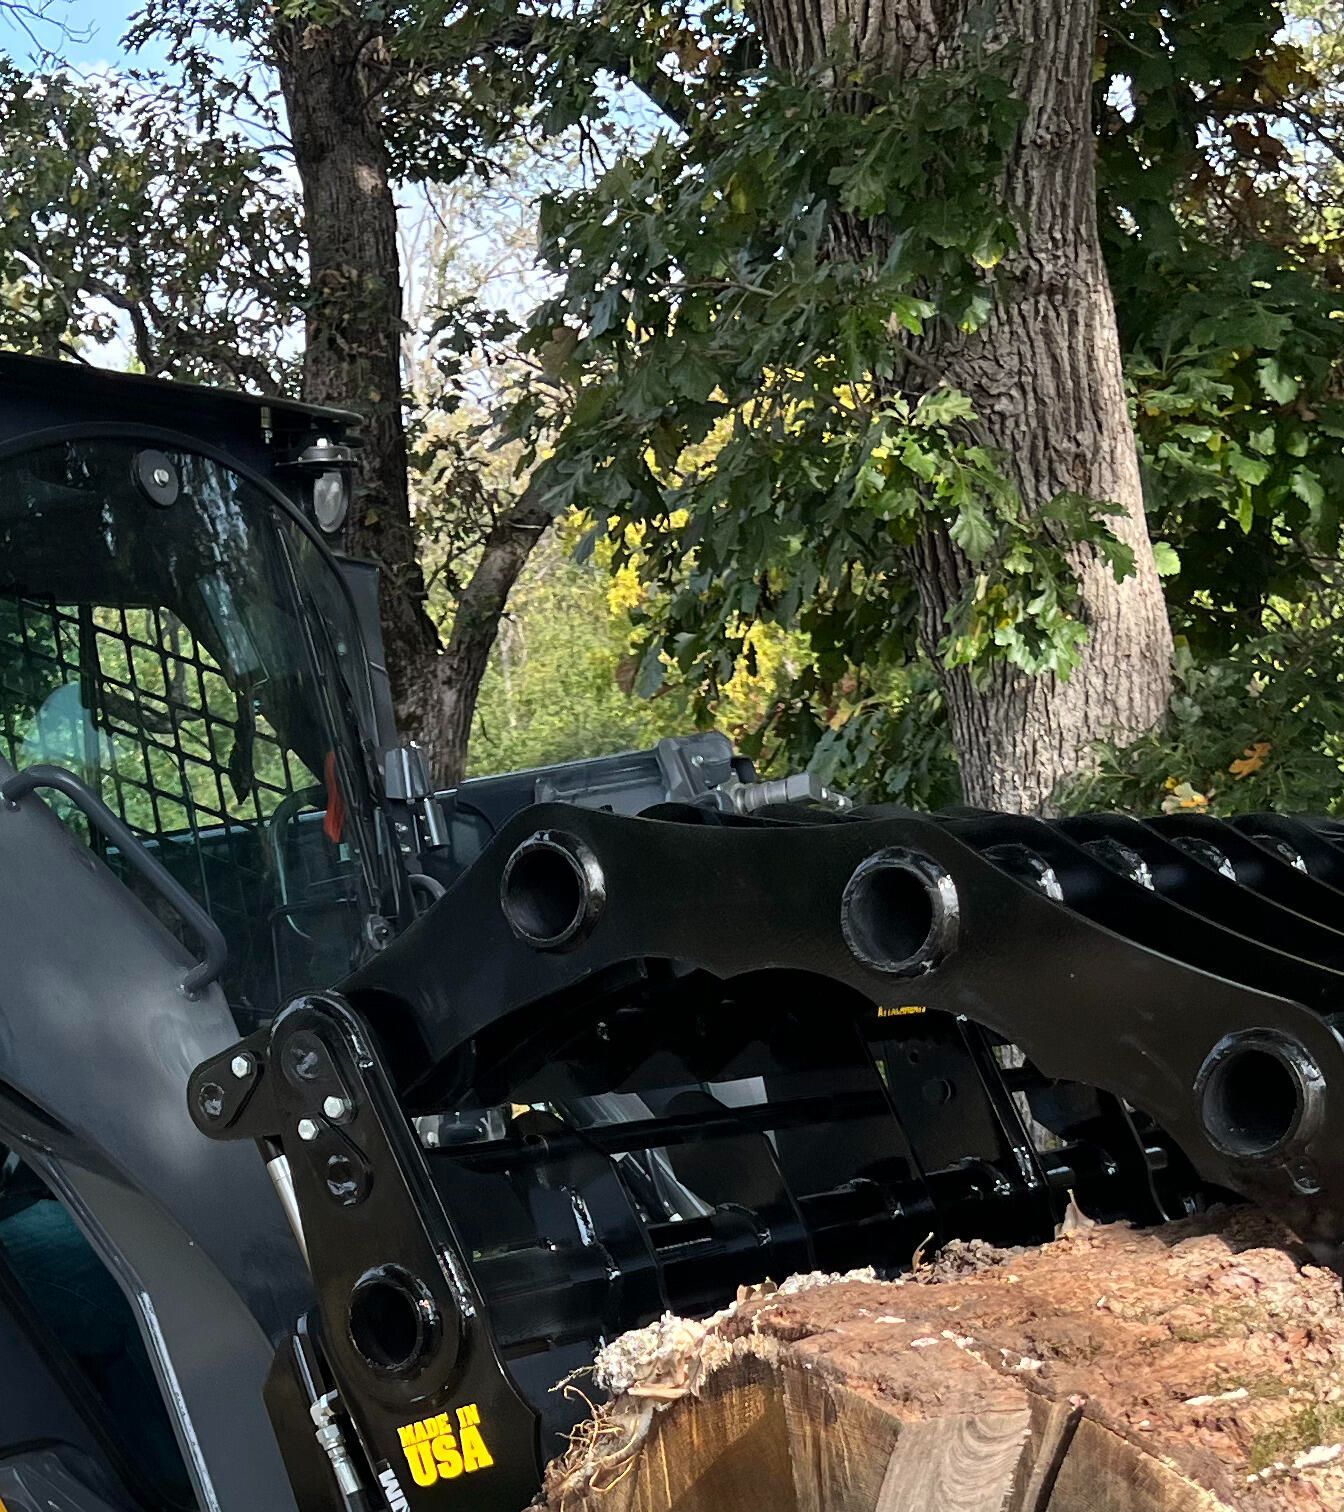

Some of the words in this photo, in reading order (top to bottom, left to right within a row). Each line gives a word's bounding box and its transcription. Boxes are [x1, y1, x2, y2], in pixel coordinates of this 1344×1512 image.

[396, 1411, 453, 1448] MADE
[455, 1403, 481, 1429] IN
[403, 1424, 494, 1487] USA
